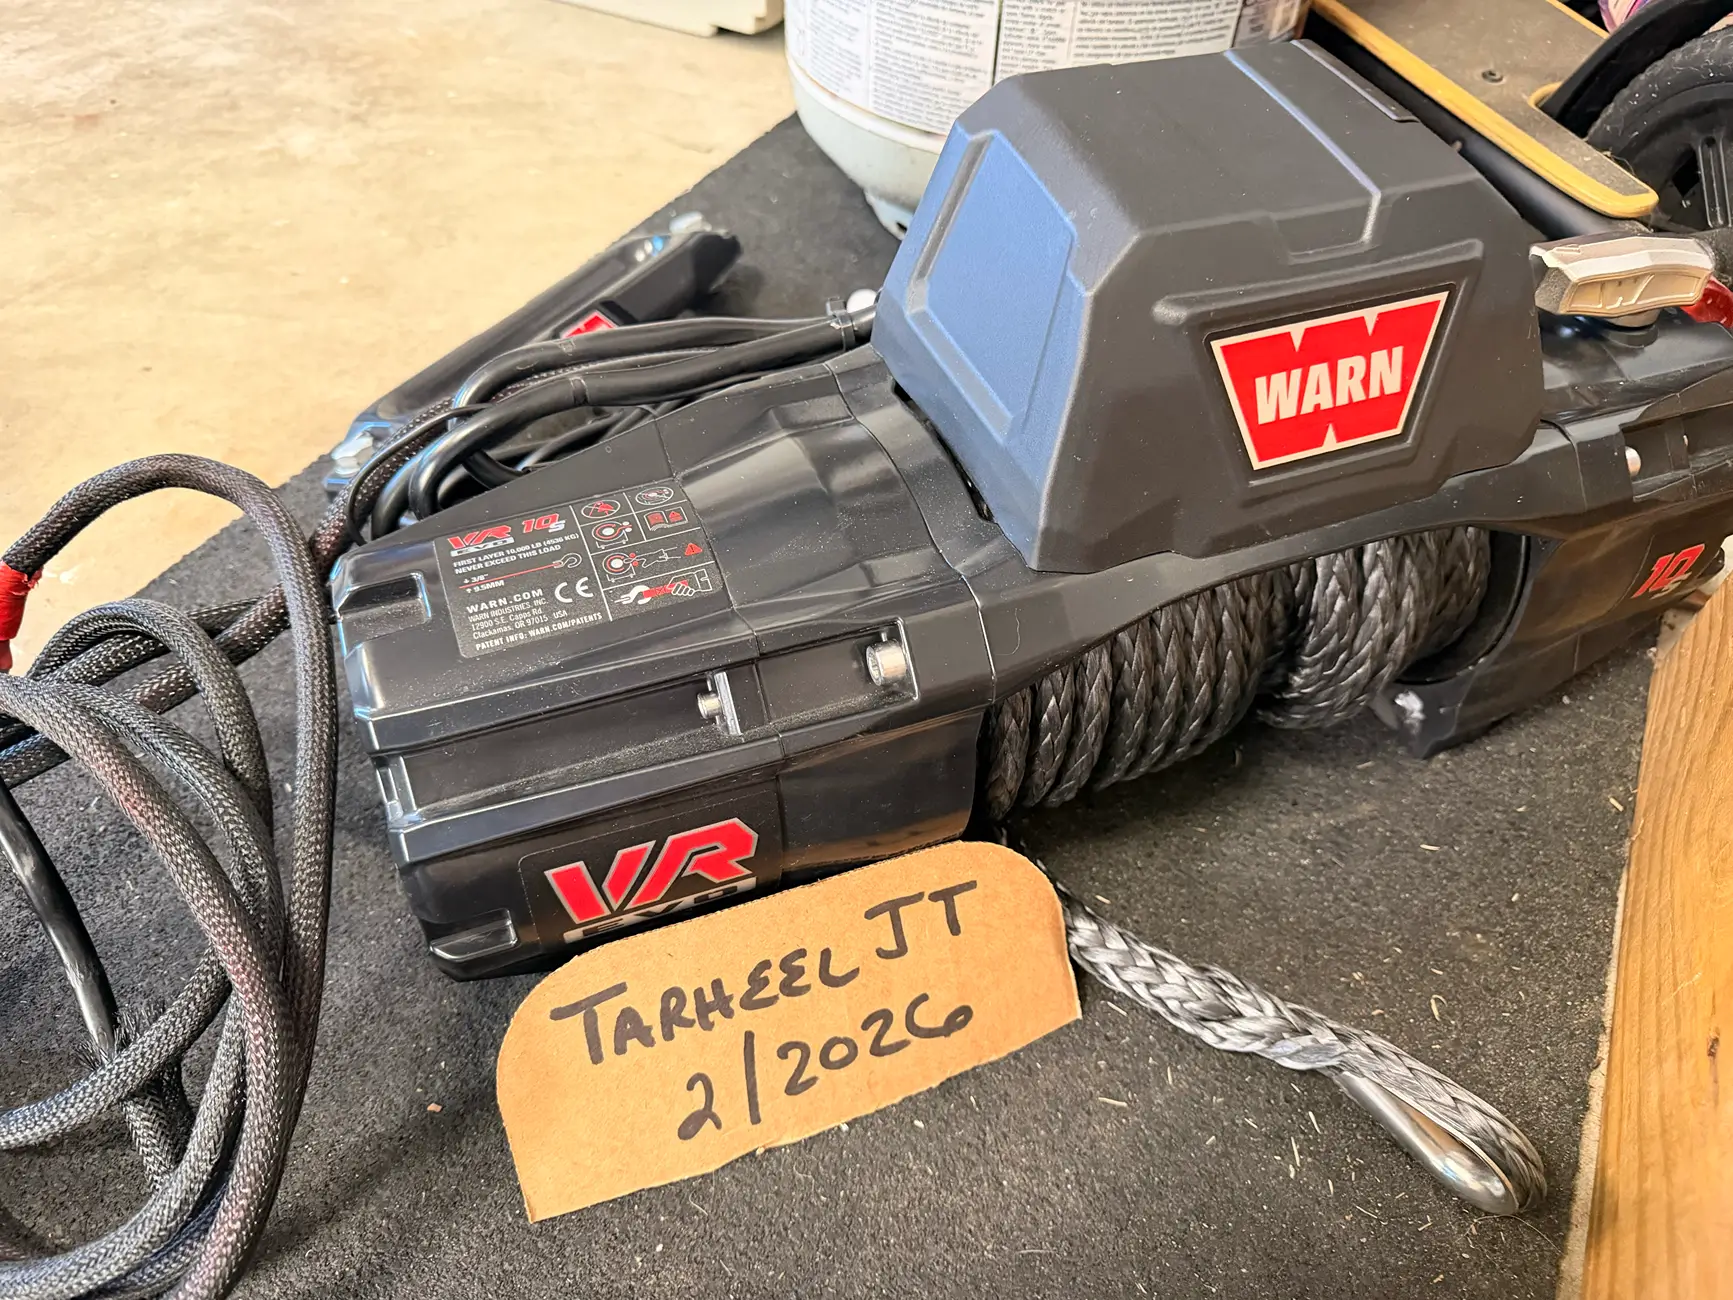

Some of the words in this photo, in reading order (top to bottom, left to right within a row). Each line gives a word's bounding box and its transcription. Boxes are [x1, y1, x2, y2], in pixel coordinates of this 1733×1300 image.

[1254, 345, 1404, 425] WARN
[447, 525, 511, 549] VR
[453, 557, 476, 567] FIRST
[478, 551, 505, 562] LAYER
[505, 545, 531, 555] 10,000
[531, 542, 542, 550] LB
[564, 533, 579, 542] KG)
[455, 561, 484, 574] NEVER
[485, 555, 517, 568] EXCEED
[518, 550, 538, 560] THIS
[539, 544, 562, 554] LOAD
[466, 588, 544, 614] WARN.COM
[474, 579, 505, 593] 9.5MM
[468, 610, 490, 623] WARN
[534, 597, 549, 606] INC.
[471, 618, 494, 631] 12900
[495, 616, 509, 626] S.E.
[509, 611, 532, 623] Capps
[514, 620, 526, 629] OR
[526, 614, 548, 626] 97015
[553, 609, 568, 619] USA
[475, 639, 504, 651] PATENT
[506, 633, 527, 644] INFO:
[528, 612, 602, 637] WARN.COM/PATENTS
[545, 818, 758, 925] VR
[551, 947, 859, 1065] TARHEEL
[864, 880, 977, 960] JT
[677, 993, 973, 1140] 2/2026
